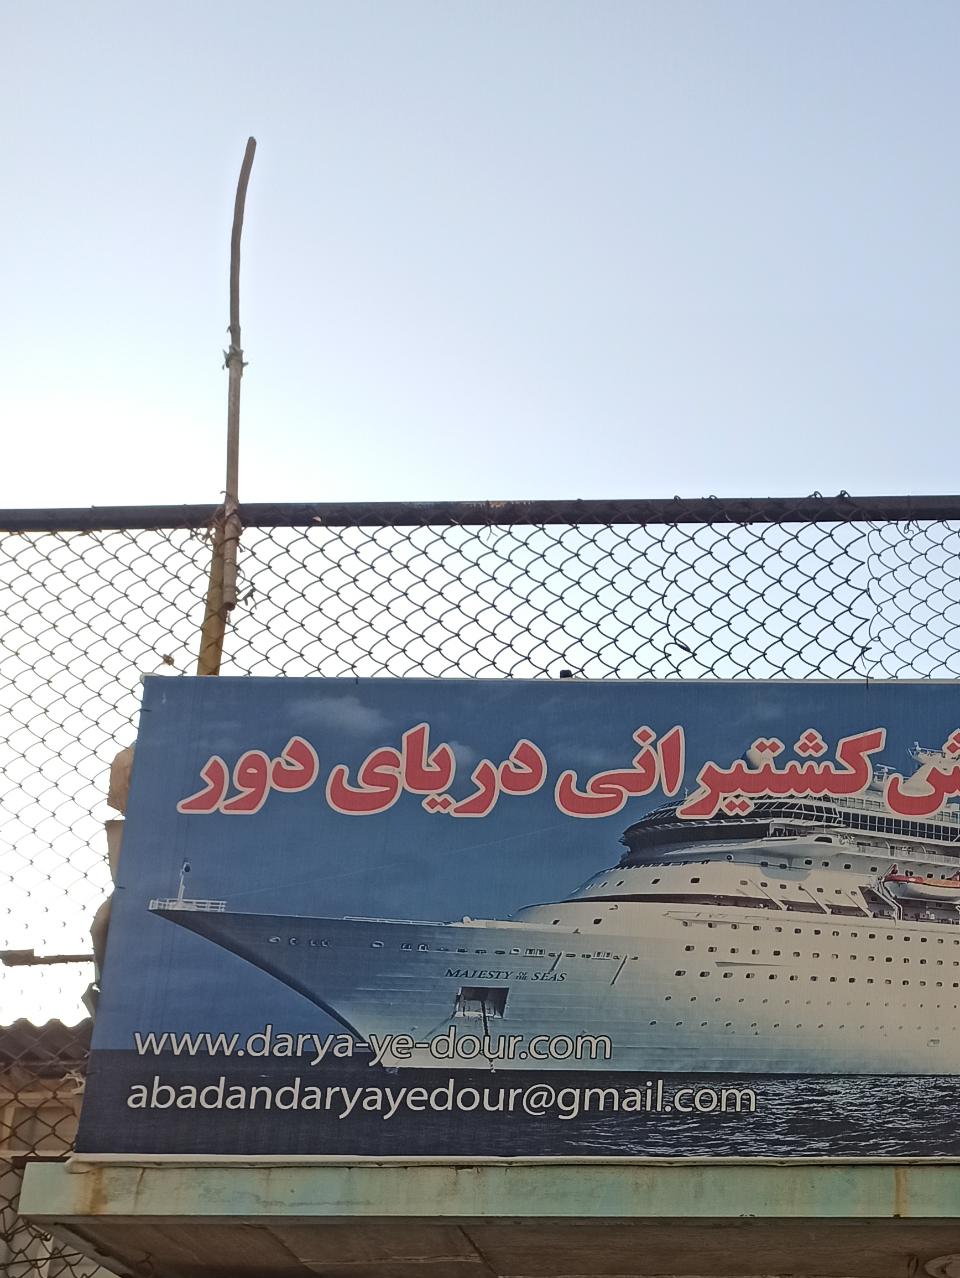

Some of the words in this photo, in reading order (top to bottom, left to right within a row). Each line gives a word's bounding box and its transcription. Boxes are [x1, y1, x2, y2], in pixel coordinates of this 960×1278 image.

[177, 735, 320, 814] دور
[325, 722, 547, 818] دریای
[554, 723, 887, 819] کشتیرانی
[445, 968, 513, 980] MAJESTY
[531, 972, 568, 982] SEAS
[134, 1024, 612, 1067] www.darya-ye-dour.com
[127, 1075, 757, 1120] abadandaryayedour@gmail.com
